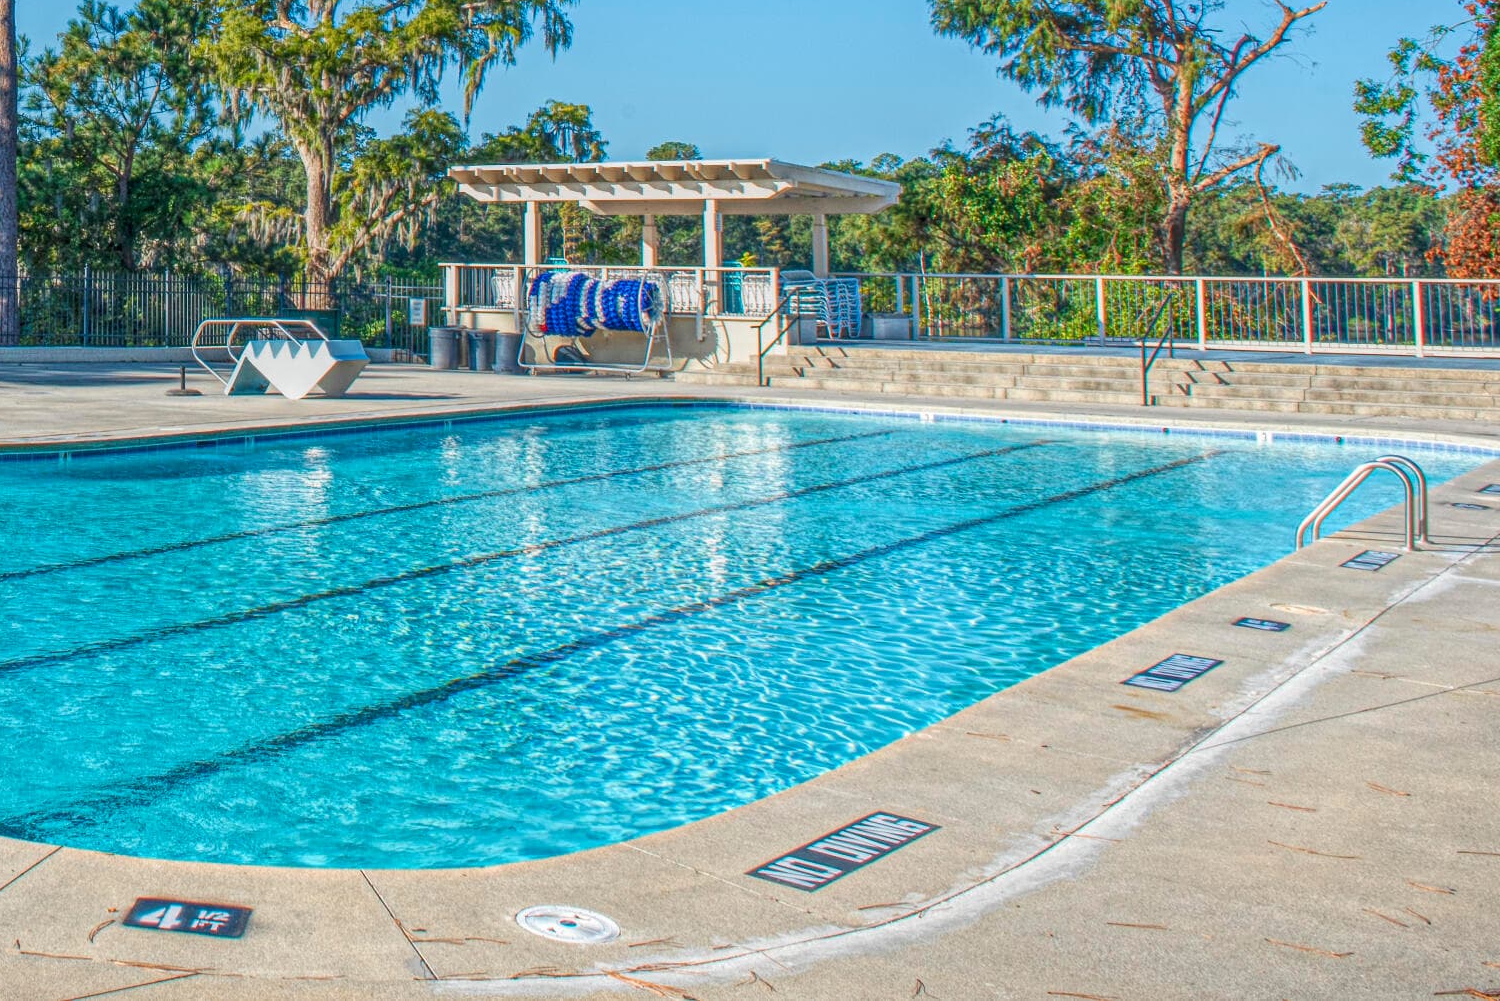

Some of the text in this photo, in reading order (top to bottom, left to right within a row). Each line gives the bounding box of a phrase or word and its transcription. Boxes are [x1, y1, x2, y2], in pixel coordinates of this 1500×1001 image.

[757, 814, 932, 889] NO DIVING
[139, 904, 183, 930] 4
